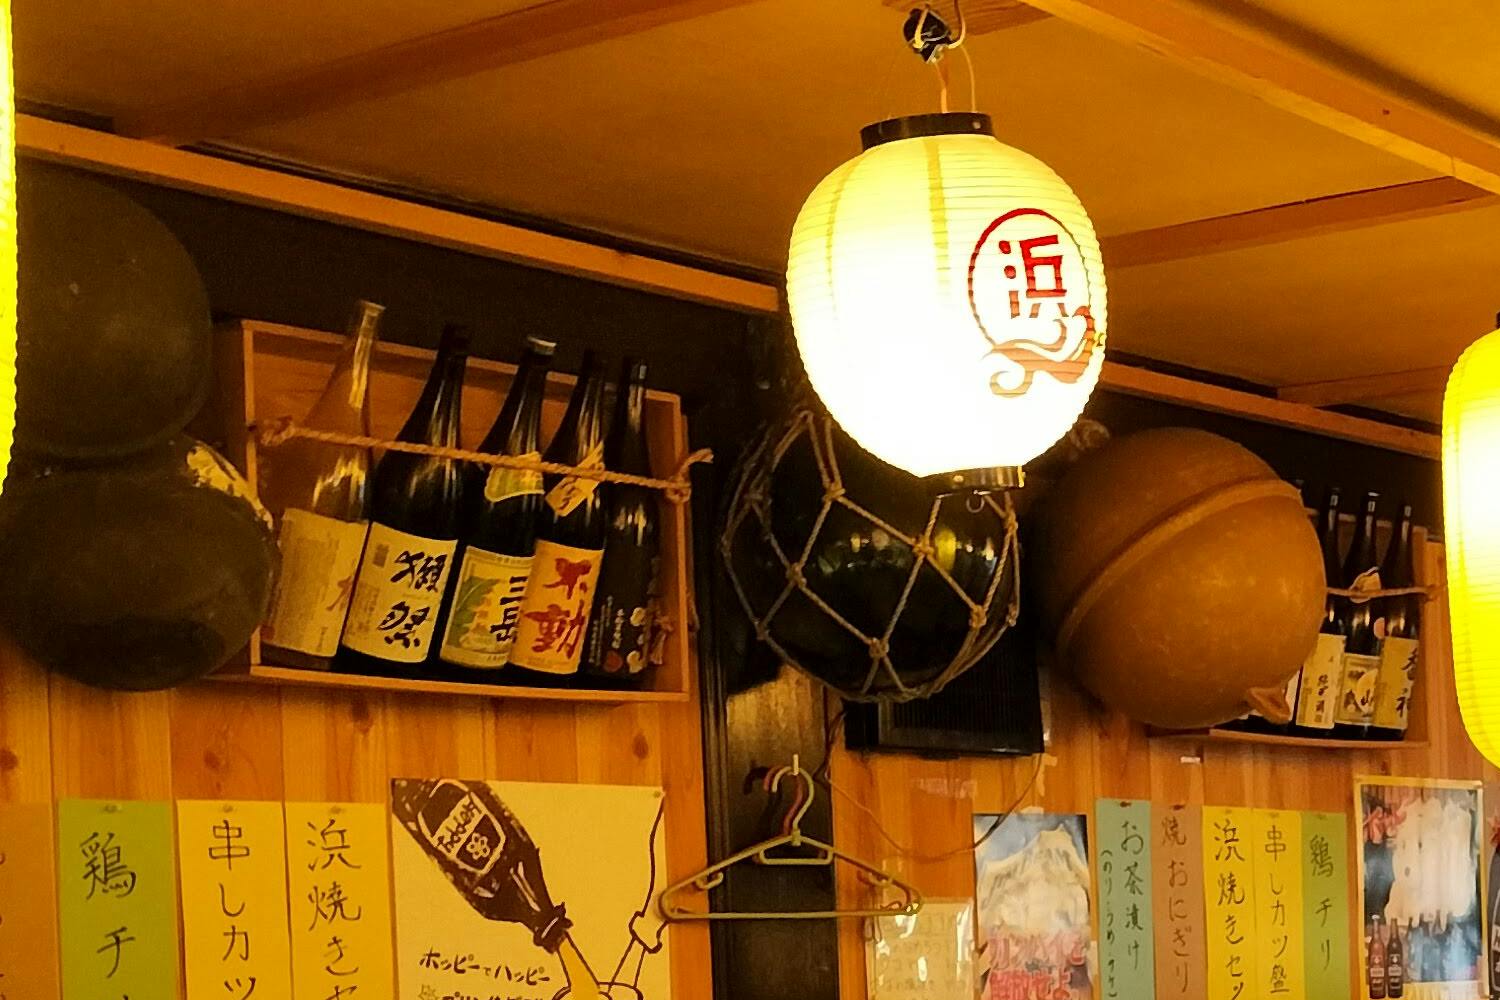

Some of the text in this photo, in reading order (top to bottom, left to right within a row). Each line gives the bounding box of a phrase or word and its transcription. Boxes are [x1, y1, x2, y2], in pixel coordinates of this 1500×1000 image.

[378, 550, 447, 649] 獺祭
[523, 558, 590, 658] 不動
[1120, 820, 1144, 970] お茶漬け
[1160, 816, 1193, 993] 焼おにぎり
[1309, 835, 1334, 970] 鶏チリ
[419, 948, 550, 986] ホッピーでハッピー
